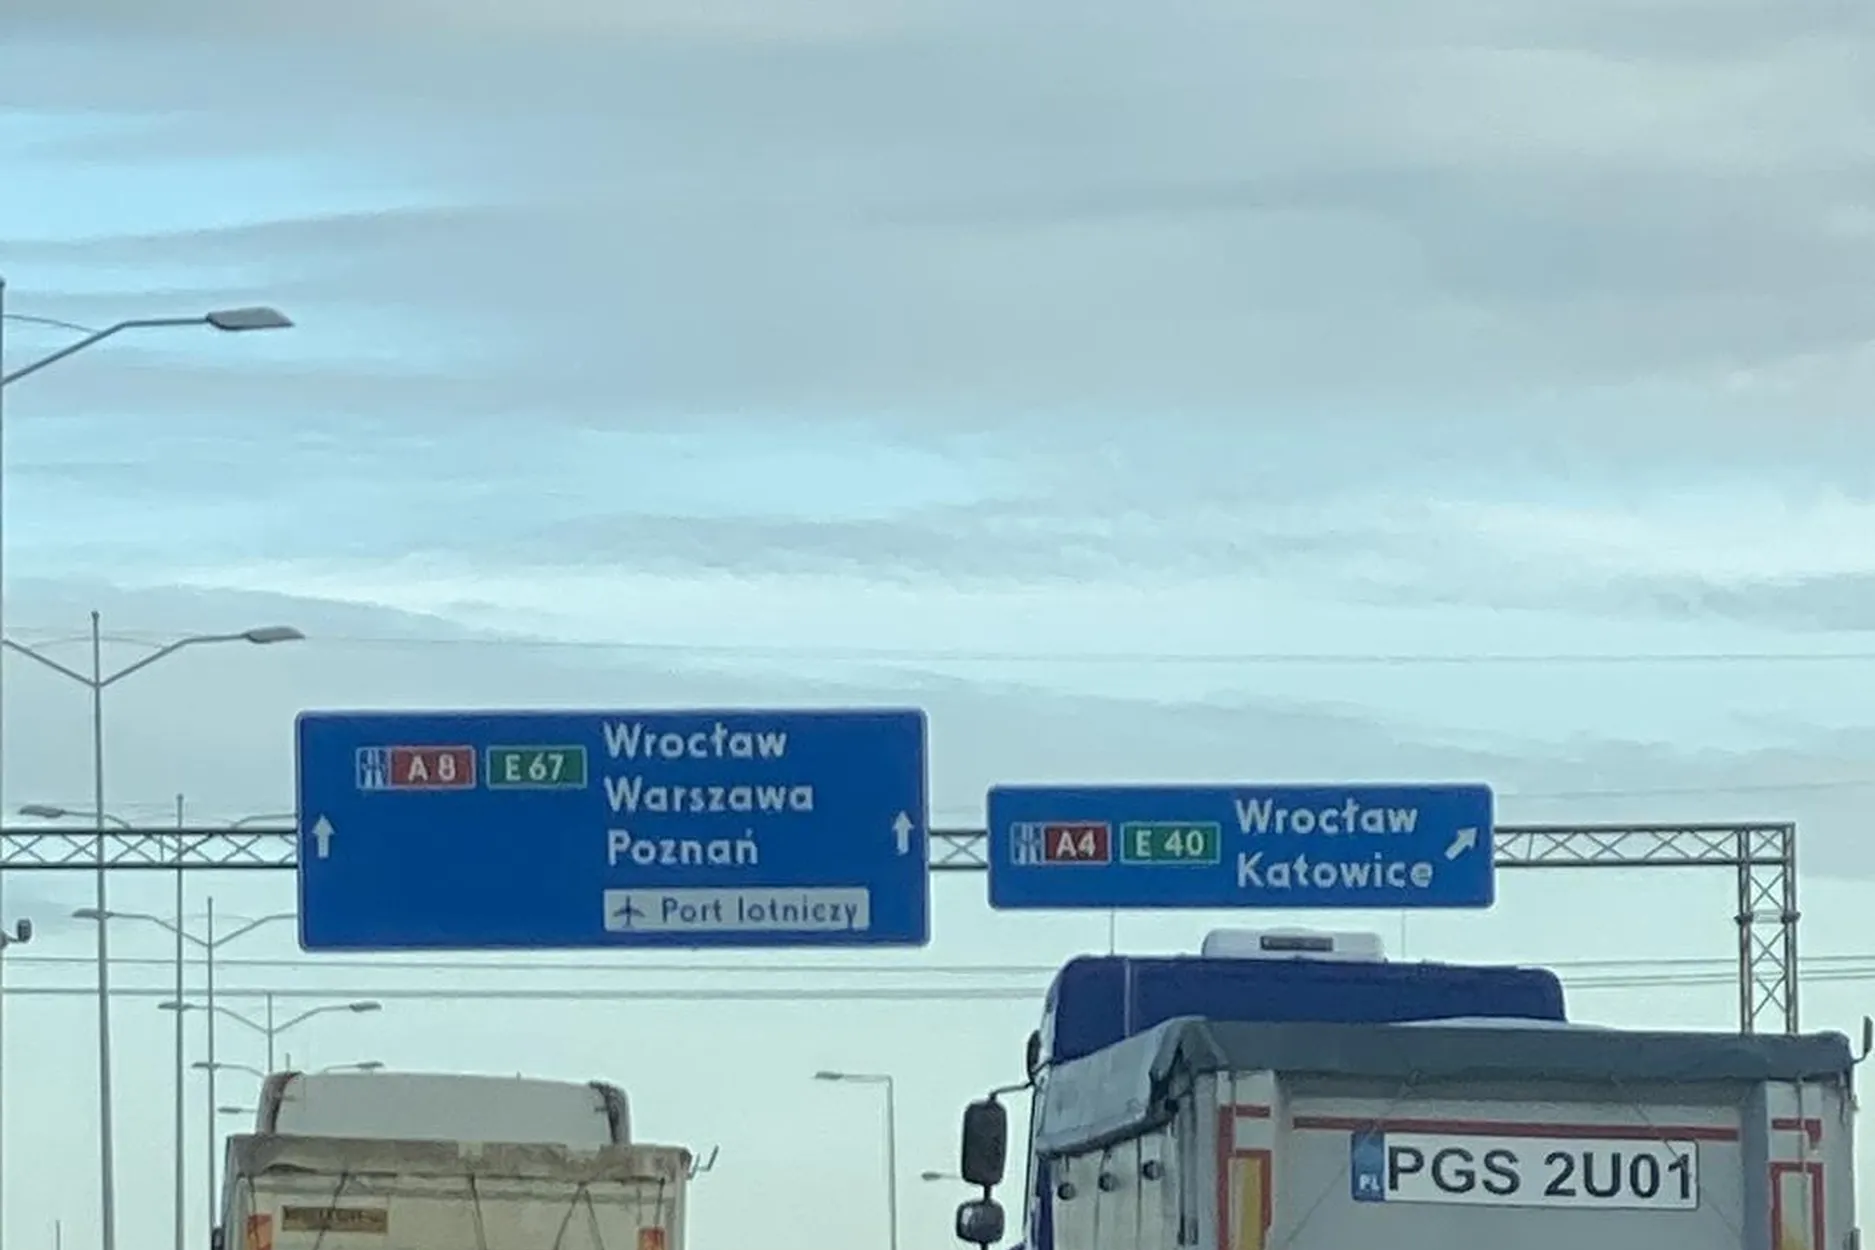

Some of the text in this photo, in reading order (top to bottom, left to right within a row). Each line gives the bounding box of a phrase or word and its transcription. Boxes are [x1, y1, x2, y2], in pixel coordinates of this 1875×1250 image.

[603, 721, 787, 759] Wrocław
[408, 754, 457, 781] A 8
[505, 752, 565, 781] E 67
[604, 775, 814, 812] Warszawa
[1235, 799, 1417, 835] Wrocław
[607, 828, 758, 866] Poznań
[1055, 829, 1097, 857] A4
[1136, 828, 1205, 857] E 40
[1238, 852, 1434, 888] Katowice
[661, 896, 858, 928] Port lotniczy
[1360, 1173, 1380, 1191] PL
[1388, 1146, 1692, 1200] PGS 2U01
